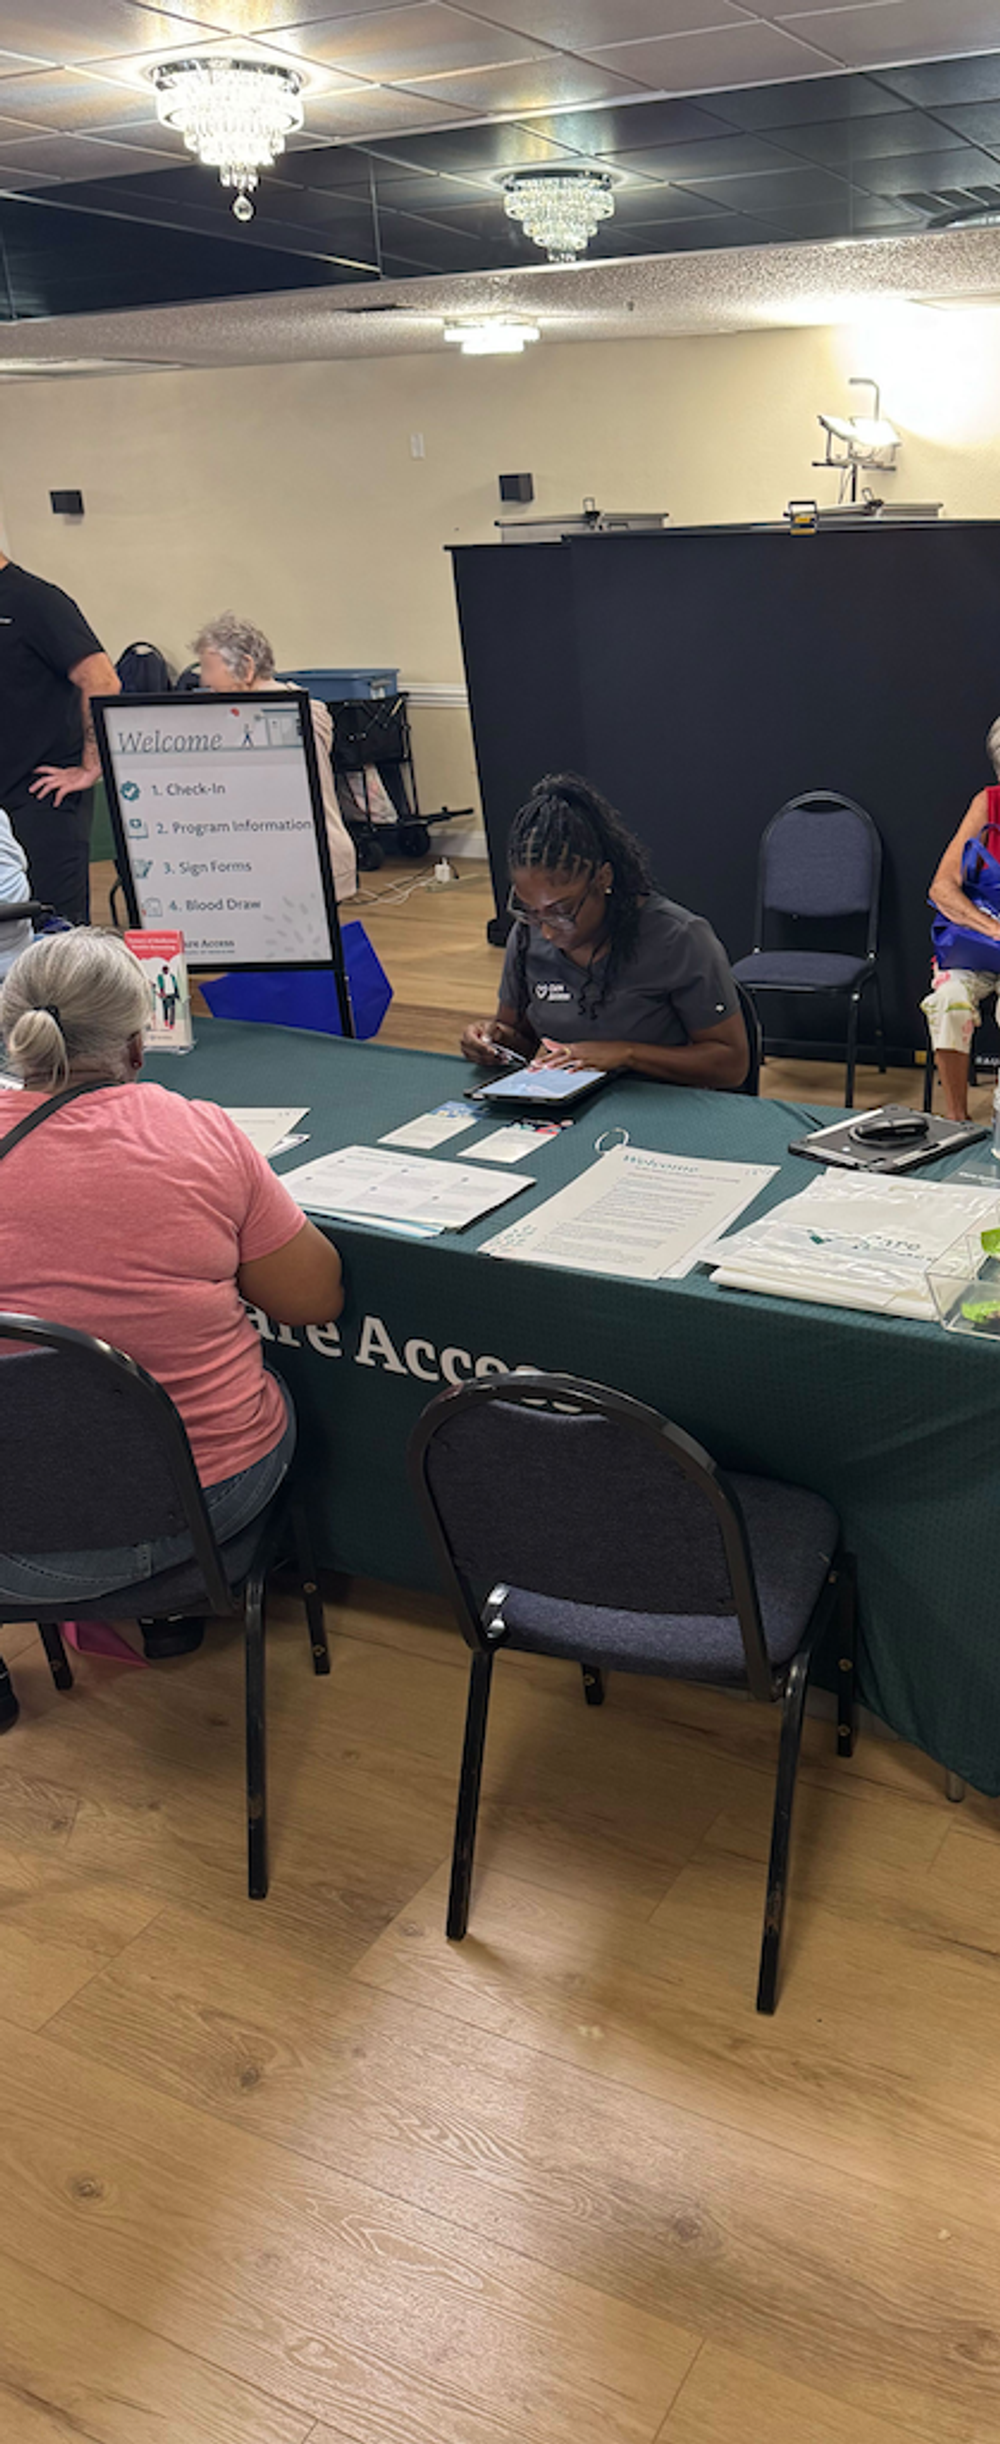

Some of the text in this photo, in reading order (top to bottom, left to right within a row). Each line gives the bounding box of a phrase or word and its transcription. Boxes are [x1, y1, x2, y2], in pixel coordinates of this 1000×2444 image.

[117, 730, 223, 752] Welcome
[151, 782, 226, 797] 1. Check-In
[157, 818, 312, 837] 2. Program Information
[164, 861, 252, 876] 3. Sign Forms
[169, 898, 261, 912] 4. Blood Draw
